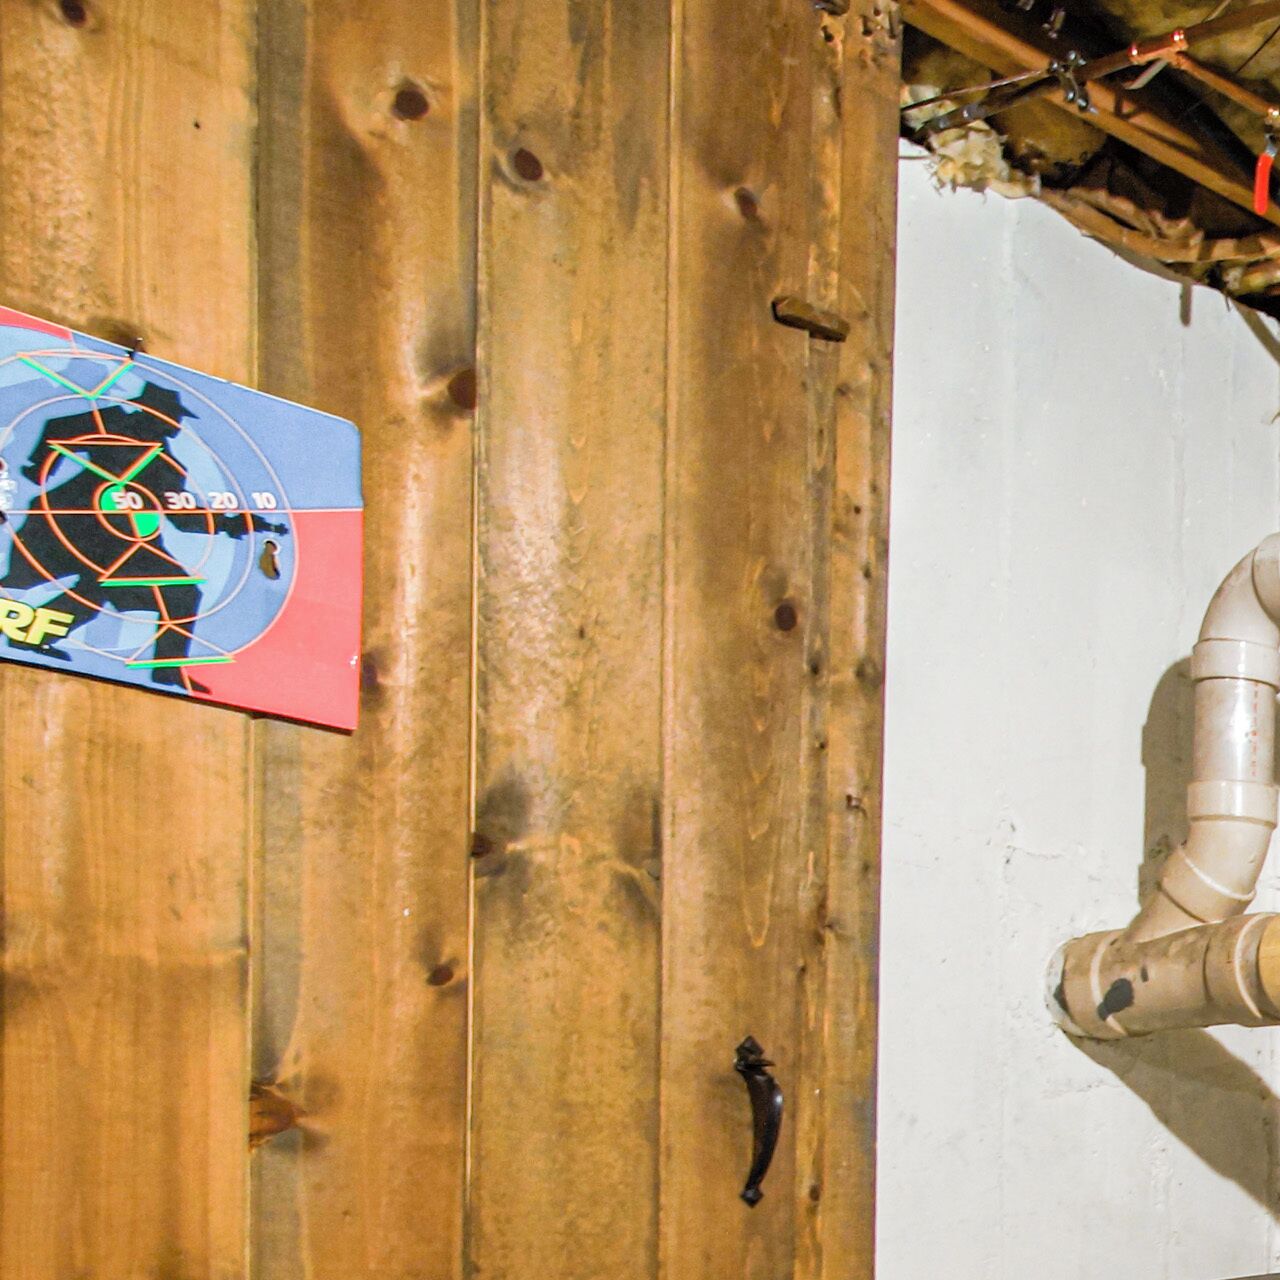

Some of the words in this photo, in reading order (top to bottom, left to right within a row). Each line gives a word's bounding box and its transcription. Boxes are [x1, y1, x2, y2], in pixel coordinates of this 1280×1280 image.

[111, 491, 144, 509] 50
[164, 491, 196, 509] 30
[208, 491, 238, 509] 20
[251, 491, 277, 509] 10
